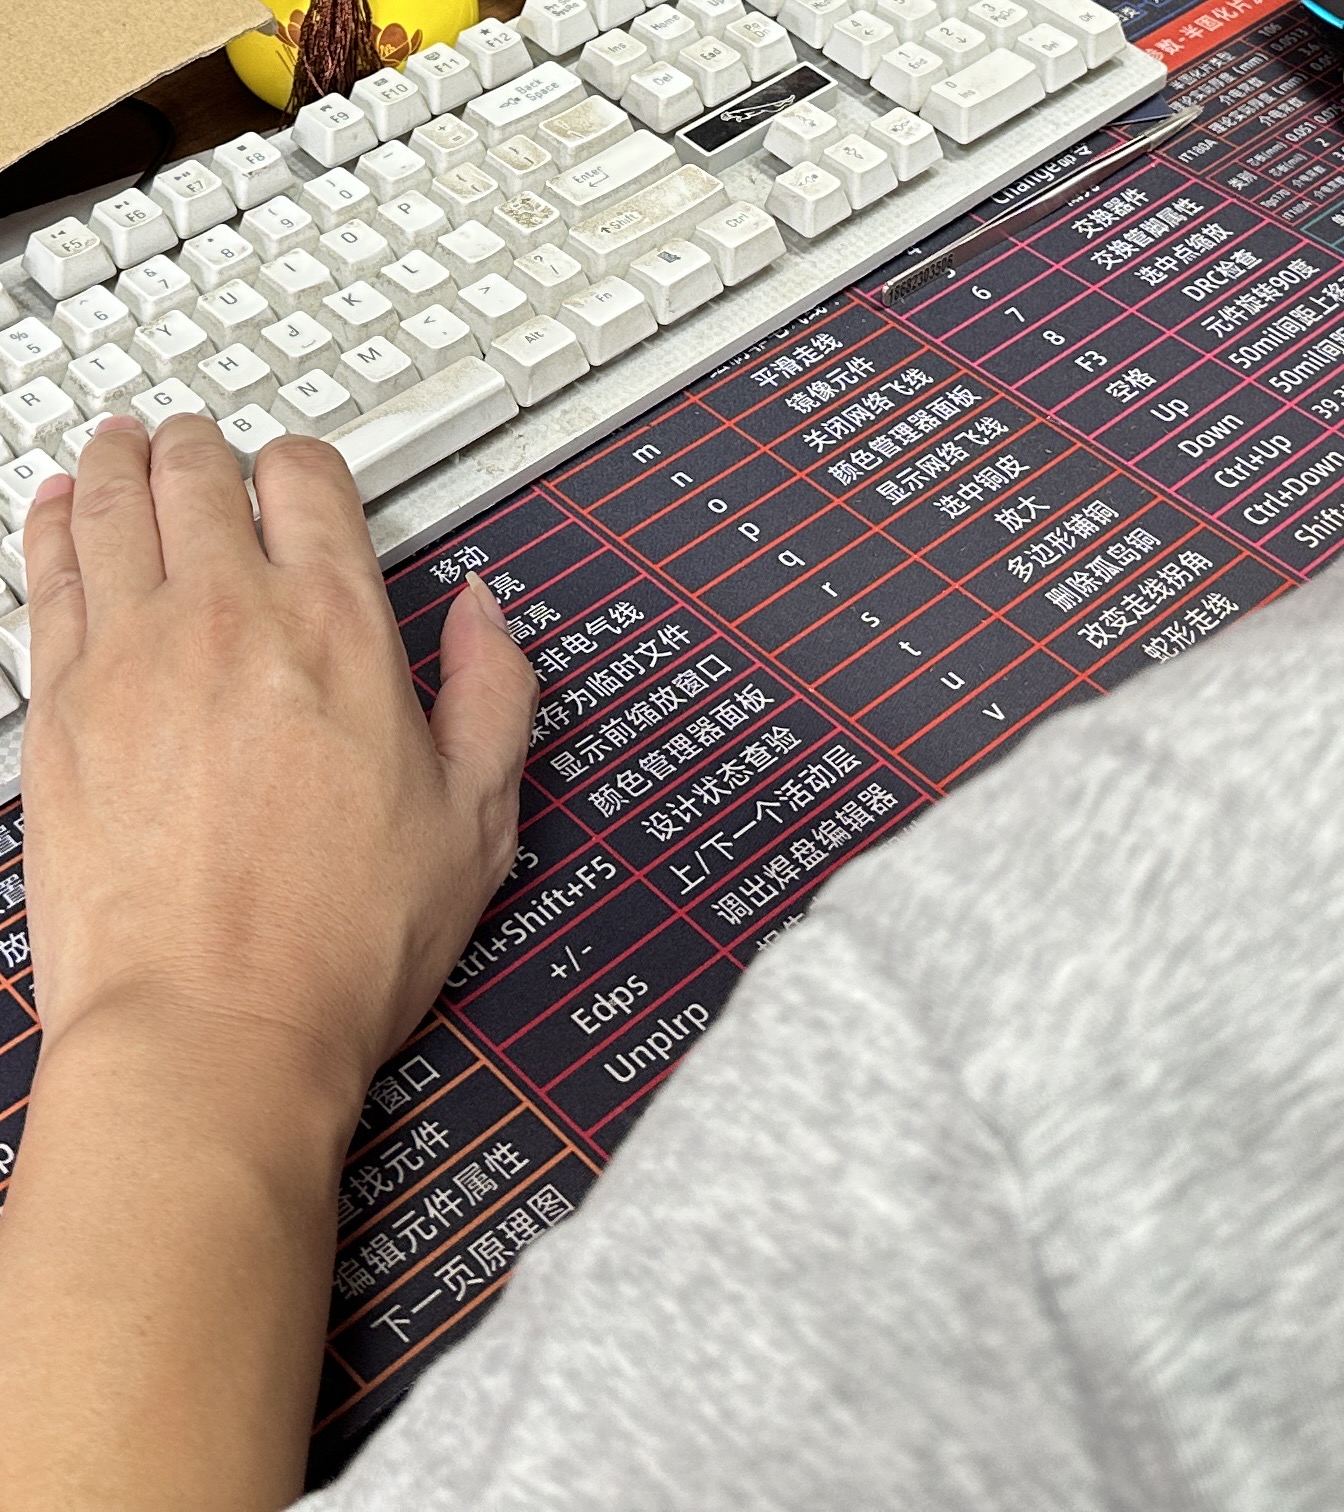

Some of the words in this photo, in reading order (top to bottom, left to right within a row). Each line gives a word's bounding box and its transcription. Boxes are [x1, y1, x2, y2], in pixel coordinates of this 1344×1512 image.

[380, 81, 409, 103] F10
[1071, 185, 1152, 240] 交换器件
[1090, 195, 1205, 272] 交换管脚属性
[1133, 221, 1234, 287] 选中点缩放
[1180, 246, 1263, 303] DRC检查
[1200, 257, 1320, 339] 元件旋转90度
[522, 327, 547, 346] Alt
[750, 332, 844, 389] 平滑走线
[1073, 349, 1109, 373] F3
[784, 354, 877, 415] 镜像元件
[802, 366, 935, 455] 关闭网络飞线
[1104, 367, 1158, 405] 空格
[1150, 395, 1191, 424] Up
[826, 384, 983, 486] 颜色管理器面板
[875, 416, 1010, 506] 显示网络飞线
[1177, 412, 1244, 459] Down
[1213, 432, 1293, 490] Ctrl+Up
[933, 453, 1031, 520] 选中铜皮
[993, 492, 1051, 534] 放大
[428, 544, 491, 586] 移动
[1006, 498, 1120, 585] 多边形铺铜
[1045, 526, 1163, 614] 删除孤岛铜
[1077, 549, 1215, 651] 改变走线拐角
[1143, 590, 1241, 665] 蛇形走线
[550, 652, 733, 783] 显示前缩放窗口
[587, 683, 775, 819] 颜色管理器面板
[641, 723, 802, 842] 设计状态查验
[667, 744, 863, 896] 上/下一个活动层
[710, 782, 900, 927] 调出焊盘编辑器
[570, 972, 650, 1035] Edps
[336, 1140, 529, 1299] 编辑元件属性
[370, 1183, 575, 1345] 下一页原理图
